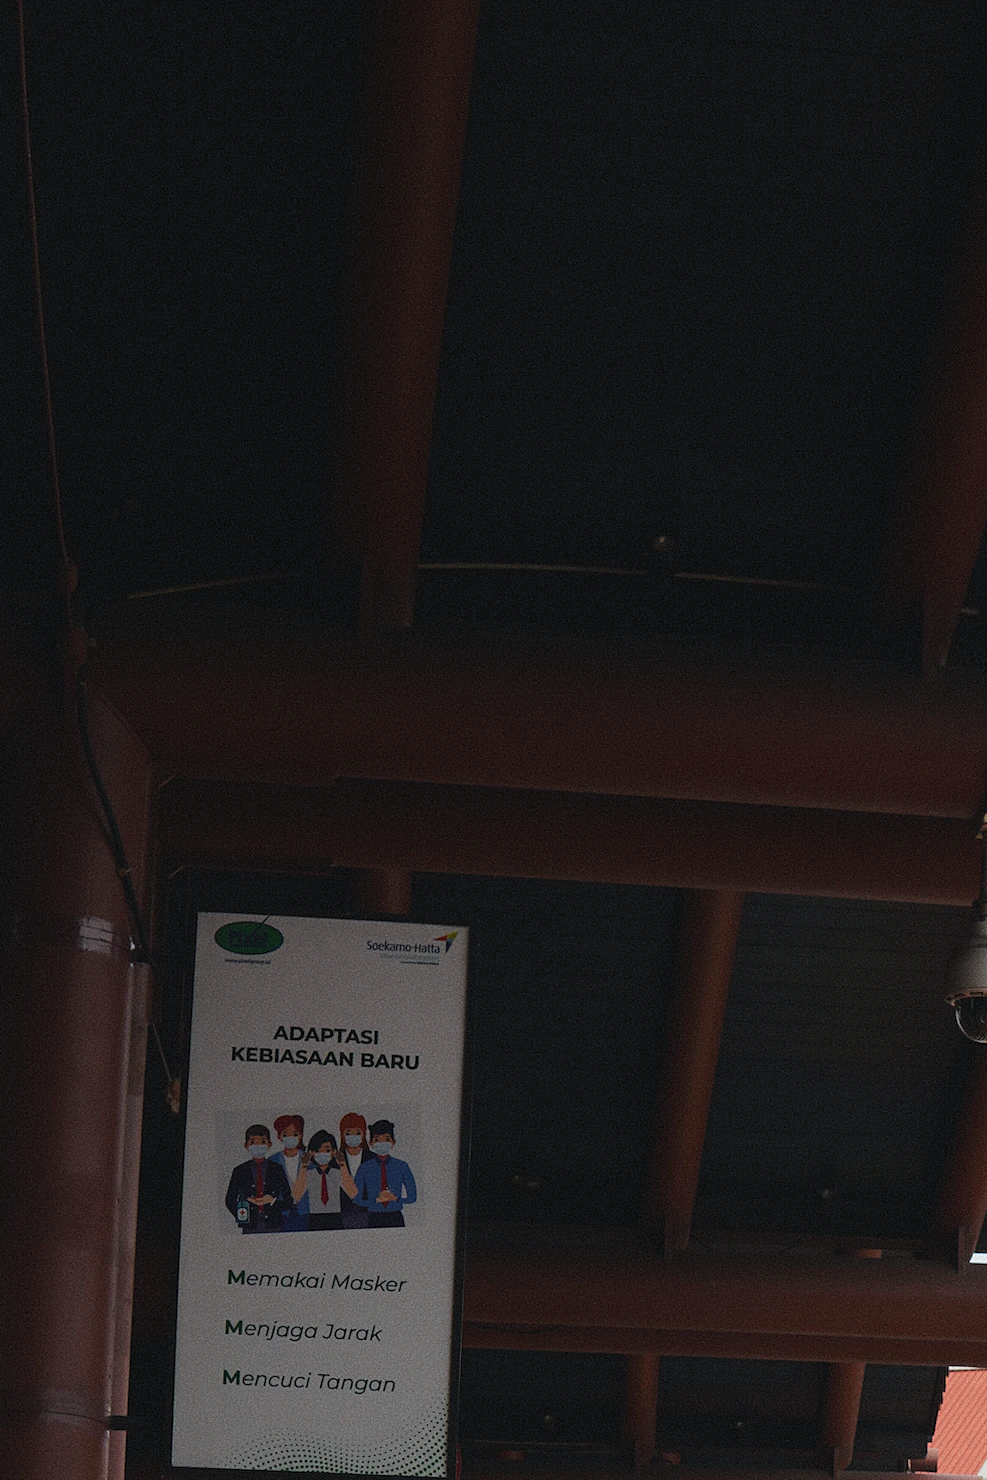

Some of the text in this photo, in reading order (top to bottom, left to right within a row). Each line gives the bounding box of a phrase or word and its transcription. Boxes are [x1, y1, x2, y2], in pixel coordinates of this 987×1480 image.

[366, 940, 440, 954] Soekarno-Hatta
[273, 1025, 379, 1045] ADAPTASI
[231, 1046, 420, 1070] KEBIASAAN BARU
[227, 1269, 407, 1292] Memakai Masker
[225, 1320, 382, 1341] Menjaga Jarak
[222, 1369, 396, 1395] Mencuci Tangan
